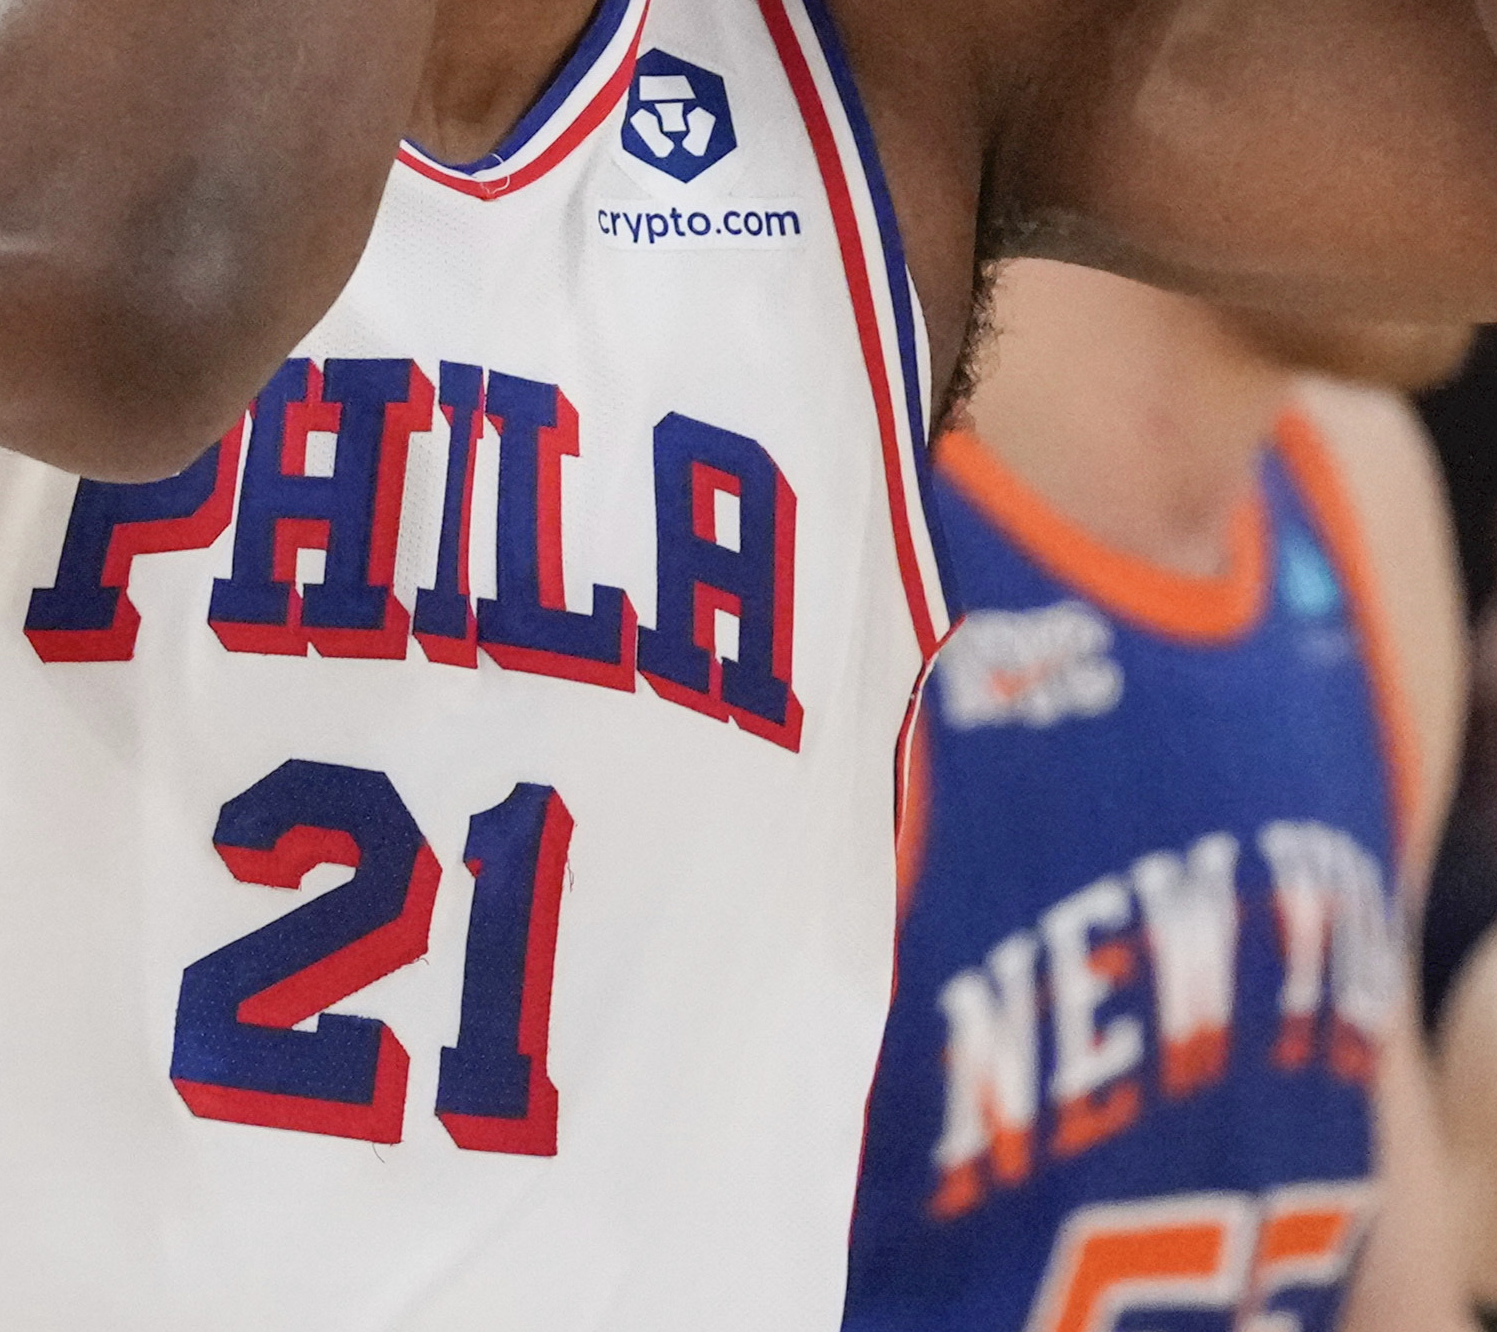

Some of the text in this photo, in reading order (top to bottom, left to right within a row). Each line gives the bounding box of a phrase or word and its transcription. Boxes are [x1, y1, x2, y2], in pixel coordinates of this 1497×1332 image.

[597, 206, 801, 244] crypto.com
[169, 758, 575, 1156] 21
[929, 830, 1241, 1219] NEW
